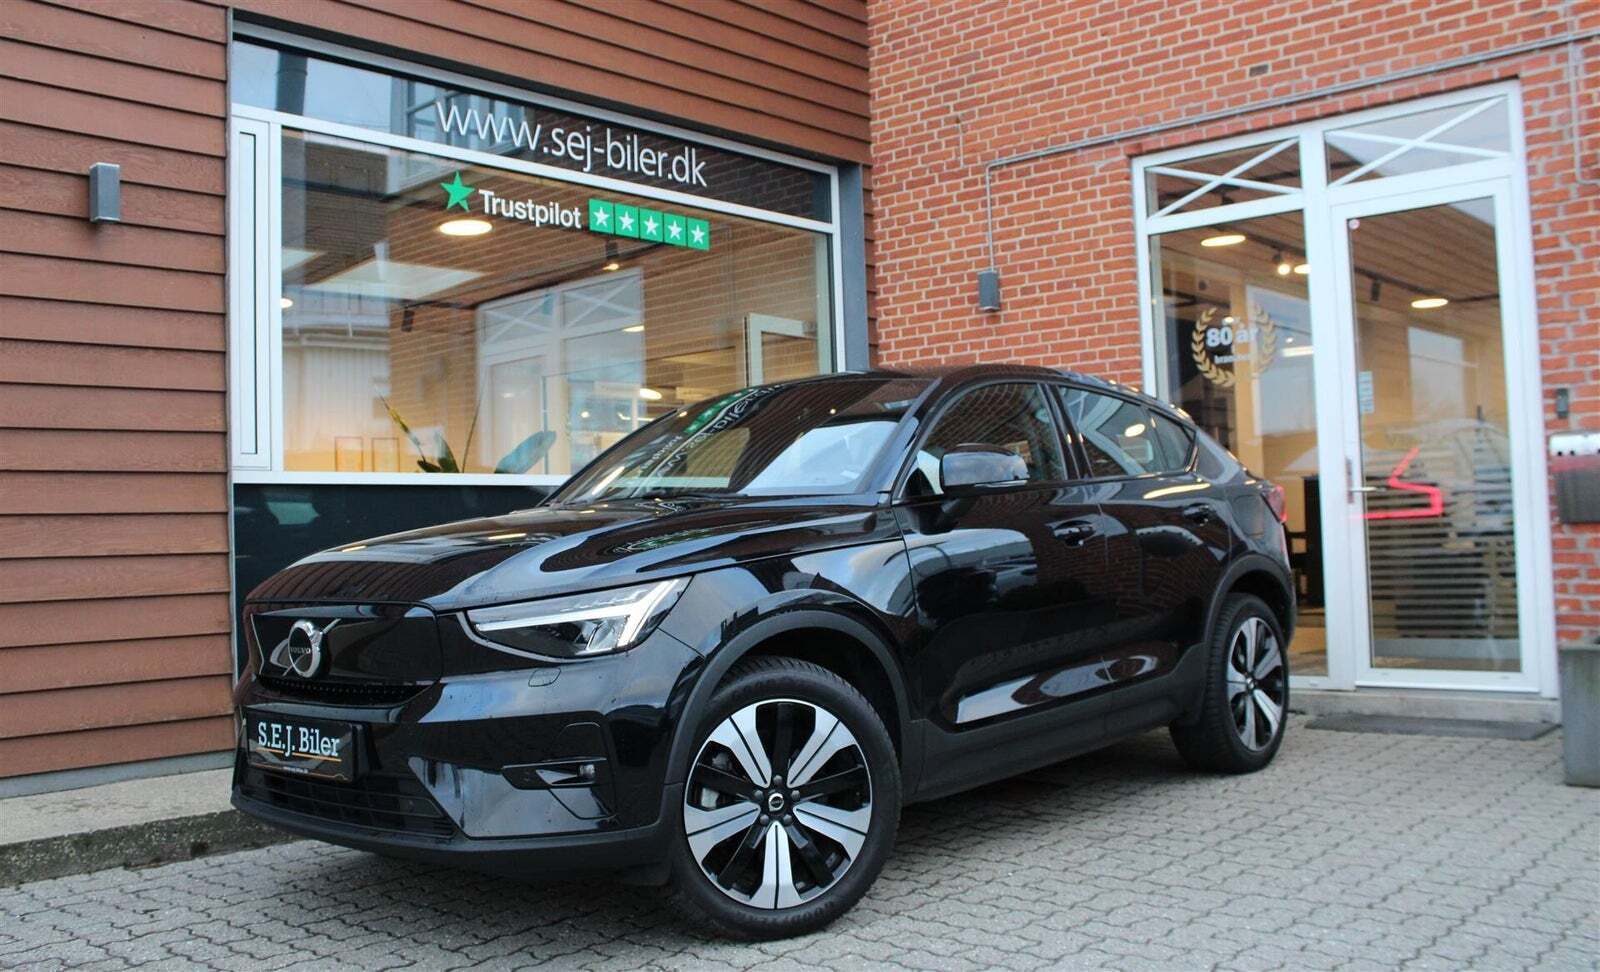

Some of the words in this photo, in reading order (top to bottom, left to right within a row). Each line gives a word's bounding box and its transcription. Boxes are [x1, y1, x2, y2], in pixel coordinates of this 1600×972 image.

[436, 101, 707, 187] www.sej-biler.dk
[478, 189, 582, 229] Trustpilot
[1206, 326, 1233, 347] 80
[290, 646, 311, 655] VOLVO
[258, 721, 296, 757] S.E.J.
[299, 726, 340, 757] Biler
